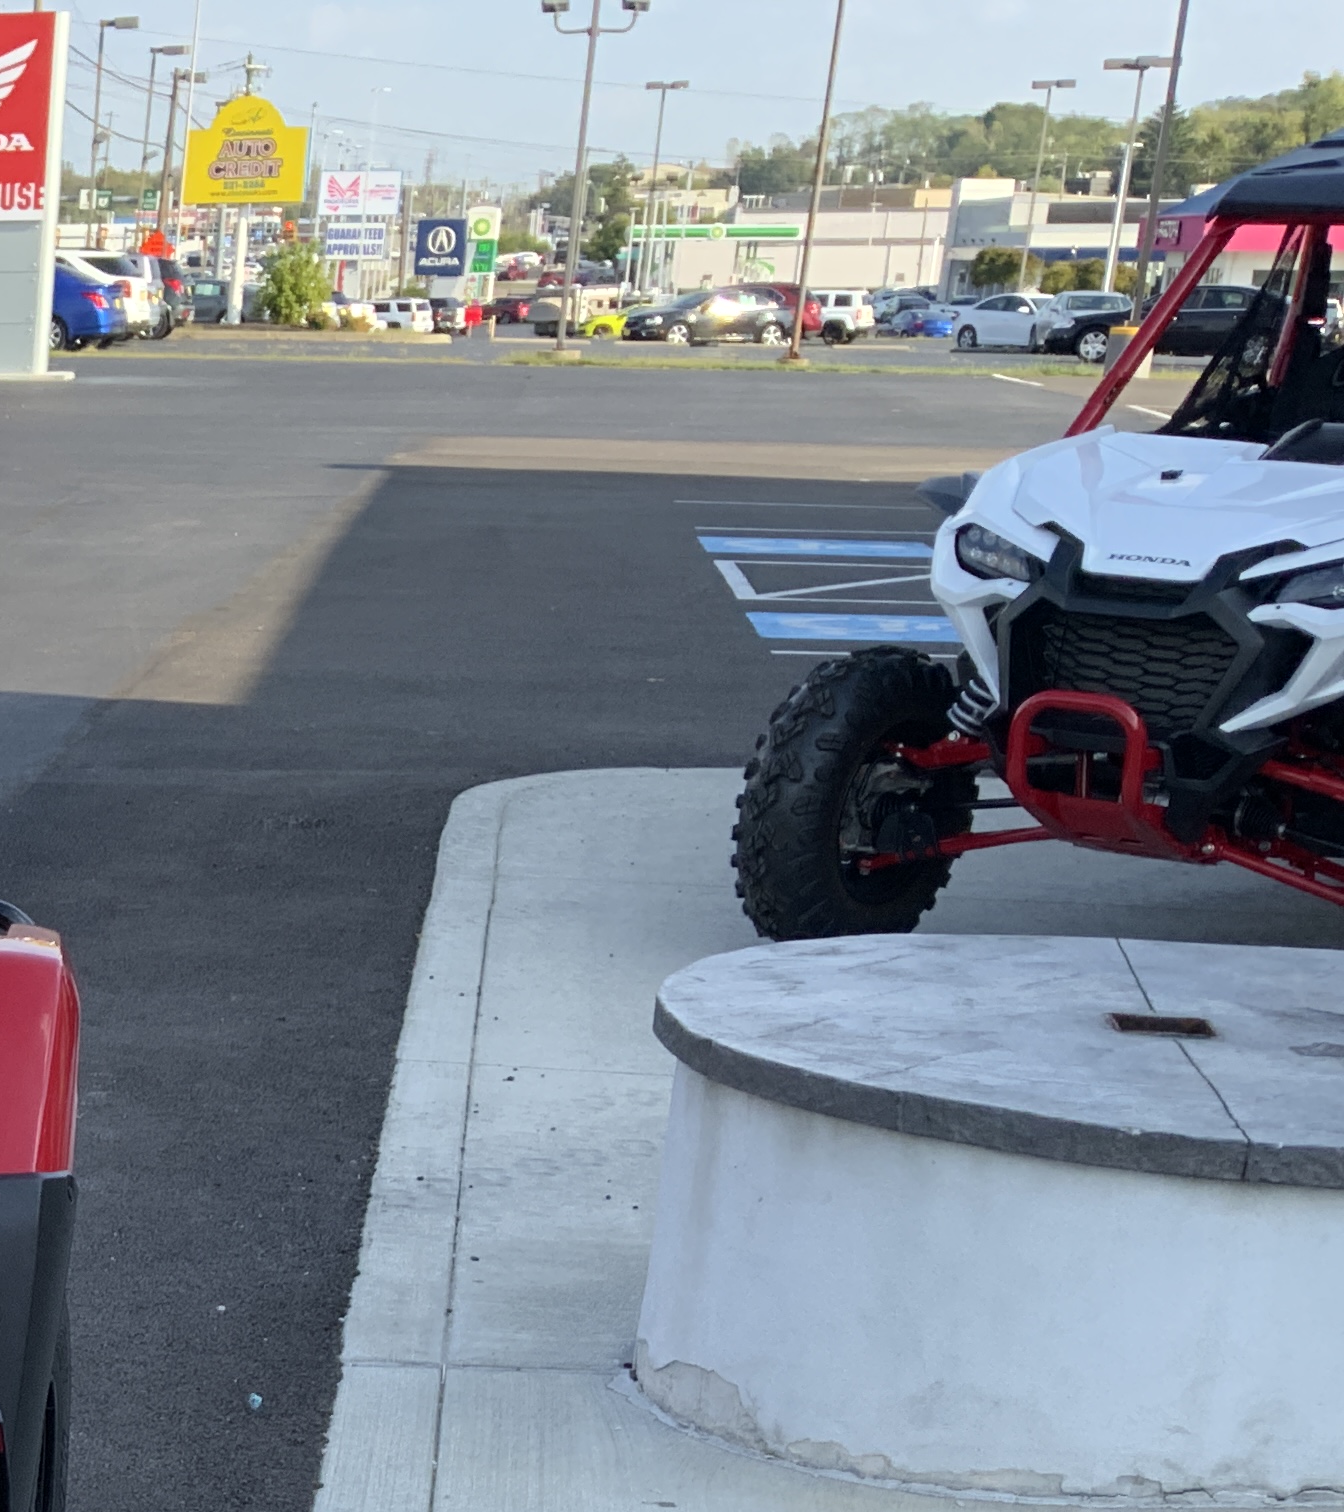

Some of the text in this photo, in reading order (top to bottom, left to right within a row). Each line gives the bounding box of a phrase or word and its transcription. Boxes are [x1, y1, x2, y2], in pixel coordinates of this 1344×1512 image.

[217, 138, 277, 158] AUTO
[208, 158, 284, 180] CREDIT
[418, 256, 460, 266] ACURA
[1108, 553, 1191, 567] HONDA
